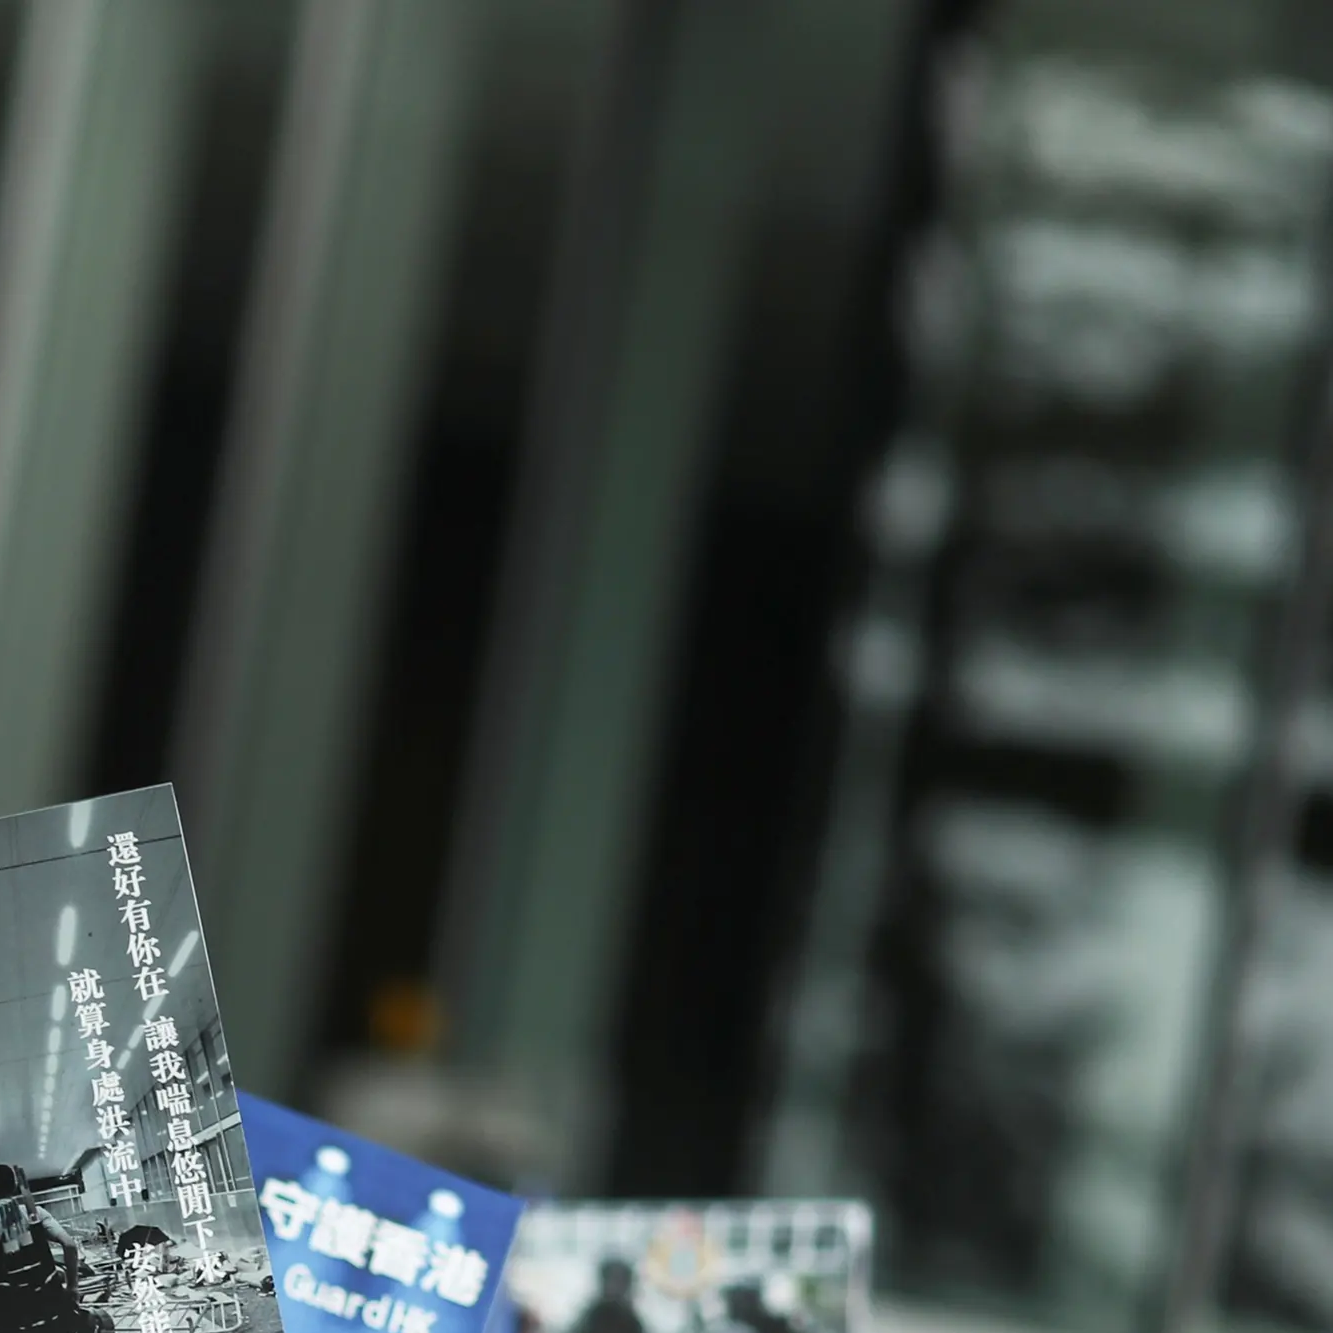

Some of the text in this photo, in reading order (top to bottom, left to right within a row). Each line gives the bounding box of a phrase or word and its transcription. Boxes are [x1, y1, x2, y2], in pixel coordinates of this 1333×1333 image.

[107, 831, 169, 1001] 還好有你在
[67, 968, 142, 1208] 就算身處洪流中
[259, 1177, 488, 1307] 守護香港
